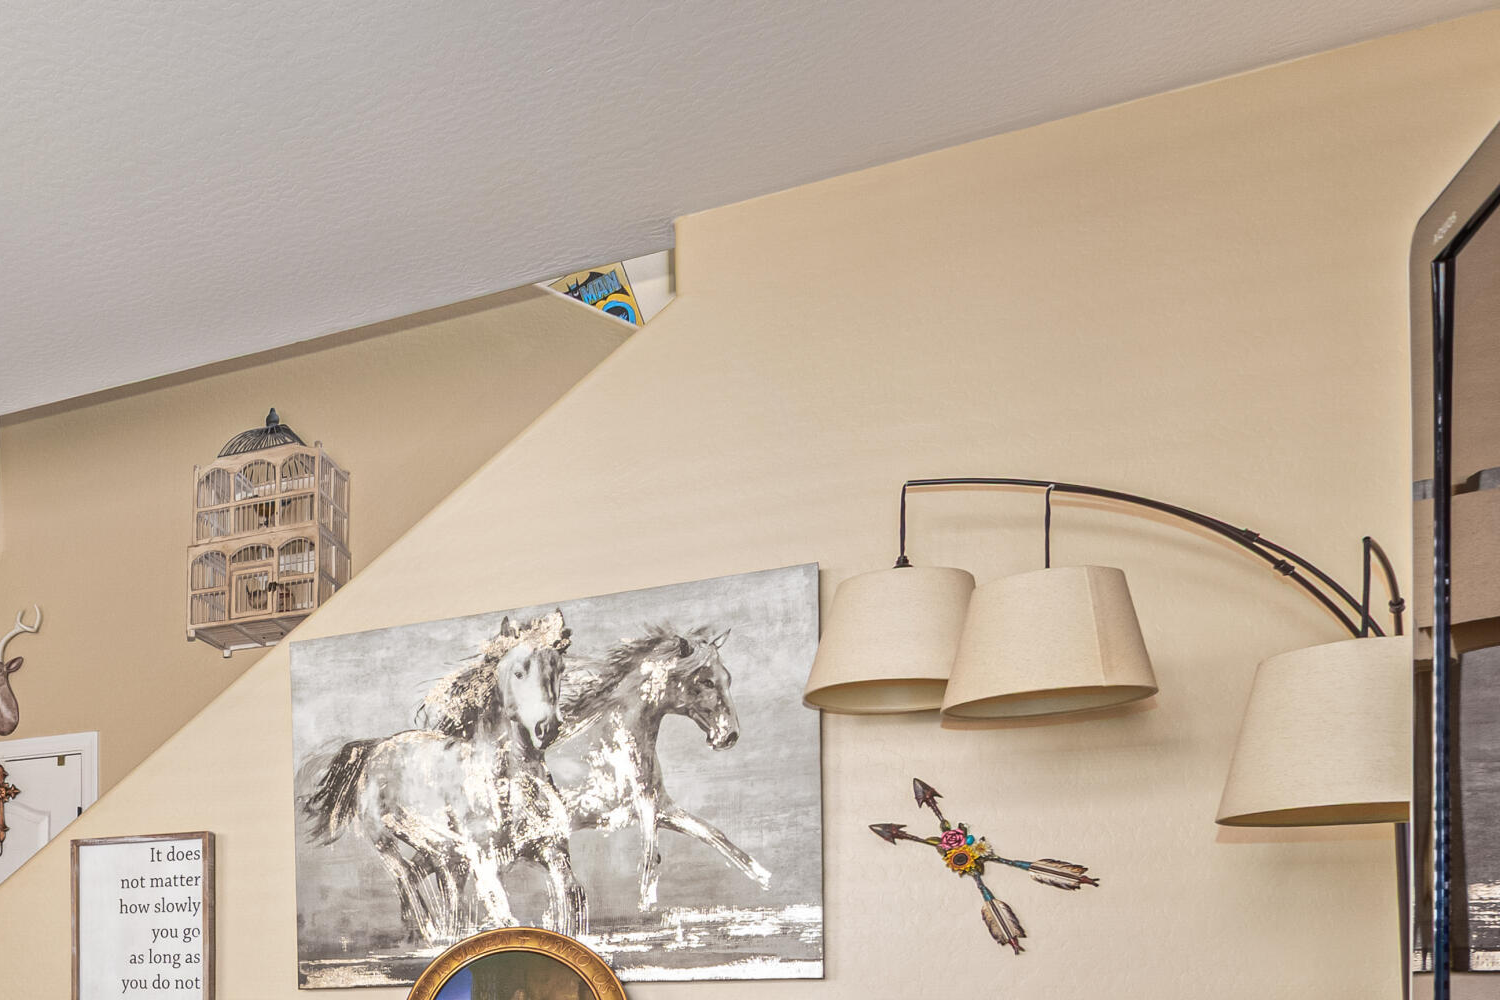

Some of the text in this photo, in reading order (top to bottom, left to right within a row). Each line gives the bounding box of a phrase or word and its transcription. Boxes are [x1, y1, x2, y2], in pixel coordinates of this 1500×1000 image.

[150, 846, 200, 862] It does
[121, 875, 200, 889] not matter
[119, 896, 201, 916] how slowly
[152, 928, 200, 943] you go
[130, 949, 200, 968] as long as
[540, 934, 592, 967] UNTO
[592, 971, 618, 995] US
[122, 974, 200, 993] you do not
